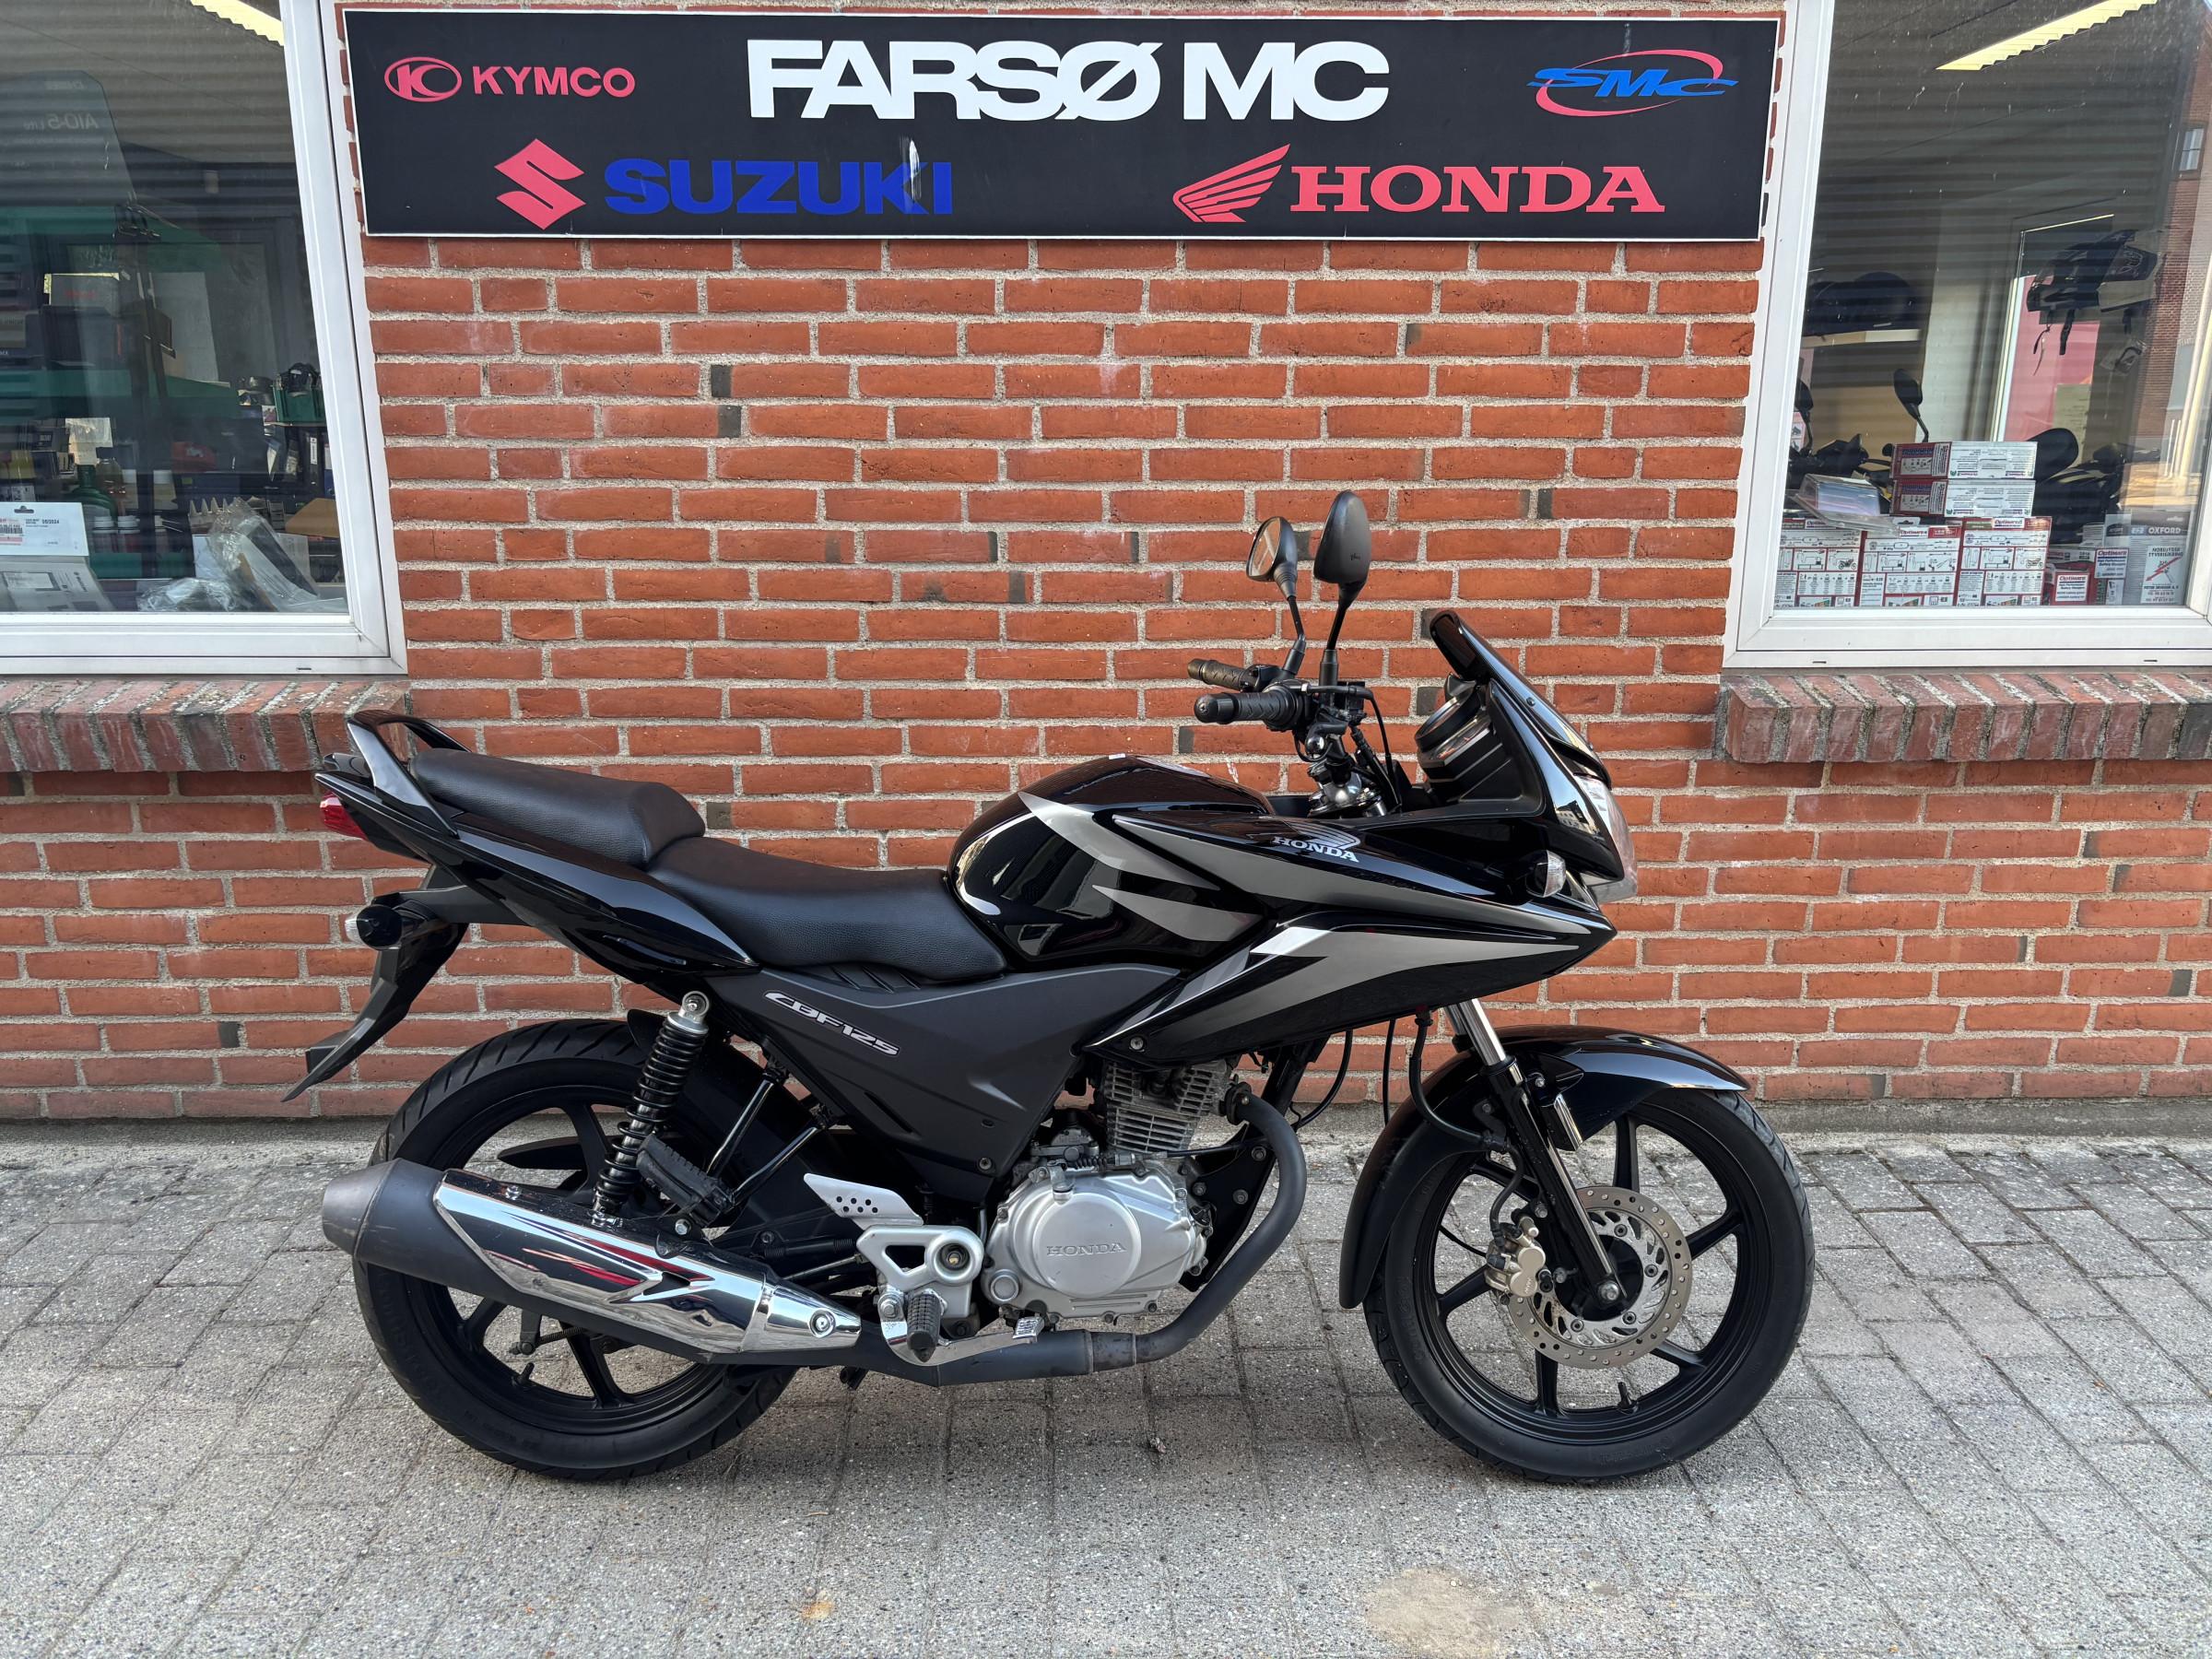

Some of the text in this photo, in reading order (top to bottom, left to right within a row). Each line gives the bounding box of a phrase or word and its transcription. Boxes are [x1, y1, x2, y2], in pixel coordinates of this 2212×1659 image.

[473, 66, 636, 99] KYMCO
[748, 41, 1390, 122] FARSØ MC
[1528, 67, 1739, 99] SMC
[605, 159, 954, 217] SUZUKI
[1290, 165, 1667, 214] HONDA
[1273, 836, 1360, 863] HONDA
[765, 992, 900, 1055] CBF125
[1046, 1242, 1127, 1256] HONDA
